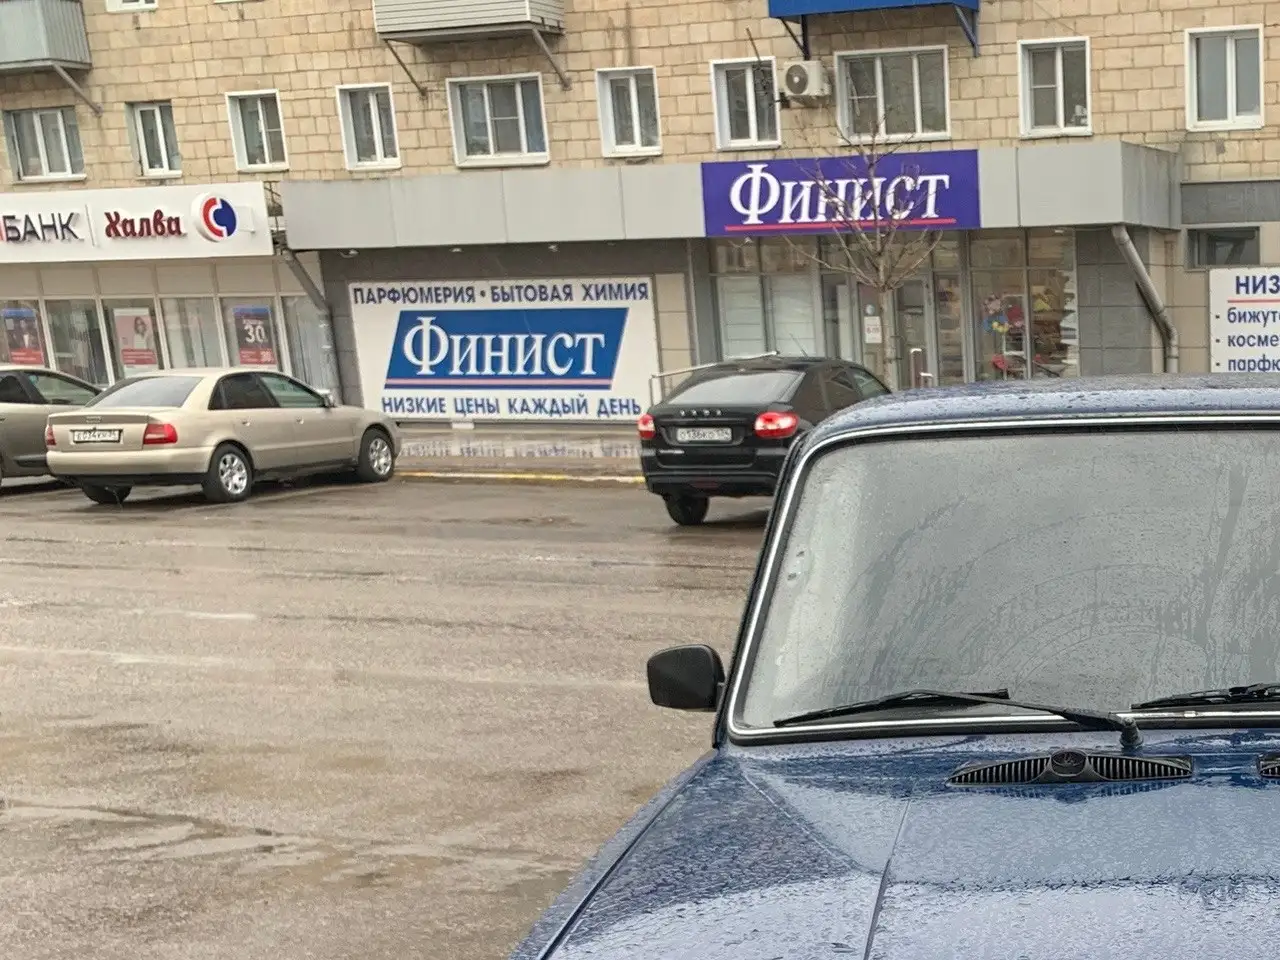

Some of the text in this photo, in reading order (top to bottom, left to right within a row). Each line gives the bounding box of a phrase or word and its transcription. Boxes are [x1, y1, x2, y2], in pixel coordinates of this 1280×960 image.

[1, 212, 80, 242] БАНК
[104, 209, 183, 238] Халва
[353, 282, 649, 305] ПАРФЮМЕРИЯ БЫТОВАЯ ХИМИЯ
[381, 393, 642, 418] НИЗКИЕ ЦЕНЫ КАЖДЫЙ ДЕНЬ
